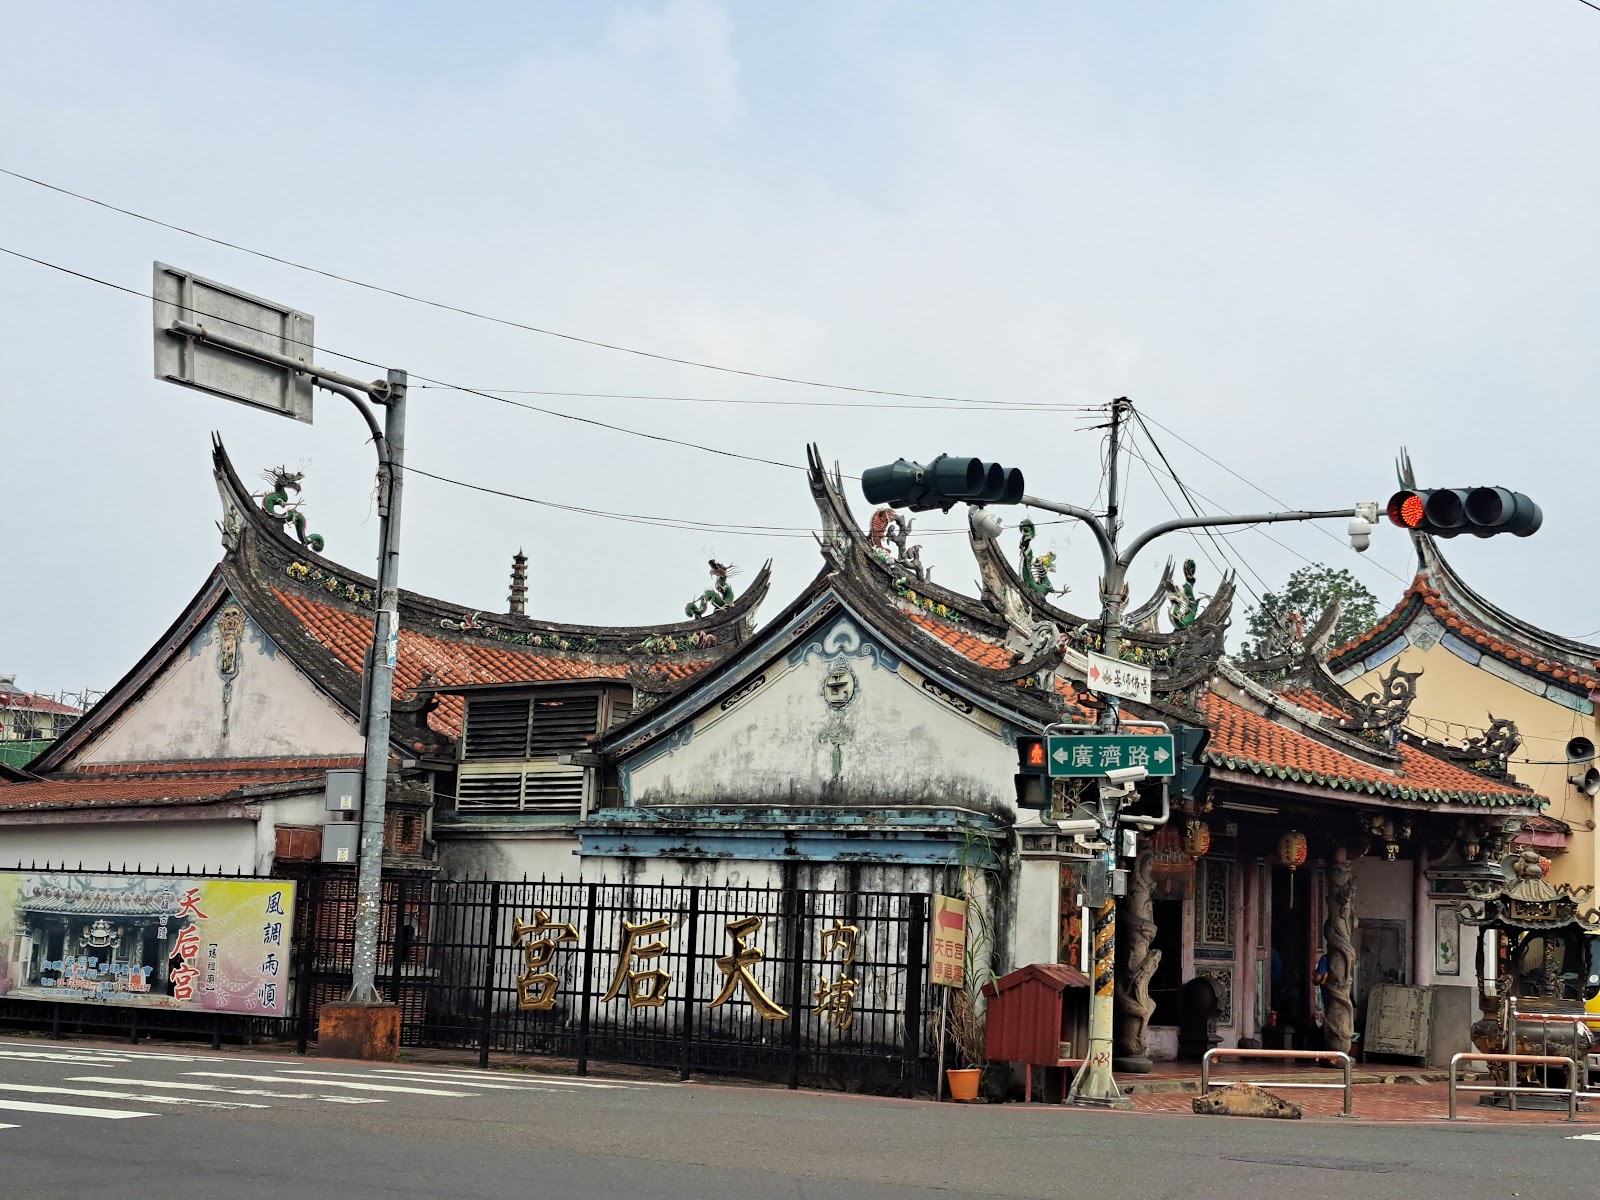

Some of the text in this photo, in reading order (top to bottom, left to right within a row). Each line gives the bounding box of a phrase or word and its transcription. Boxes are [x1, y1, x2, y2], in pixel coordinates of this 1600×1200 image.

[1071, 744, 1150, 768] 廣濟路
[169, 888, 208, 1000] 天后宮
[258, 891, 284, 1008] 風調雨順
[812, 918, 860, 1031] 內埔
[933, 961, 963, 983] 停車場
[934, 938, 964, 960] 天后宮
